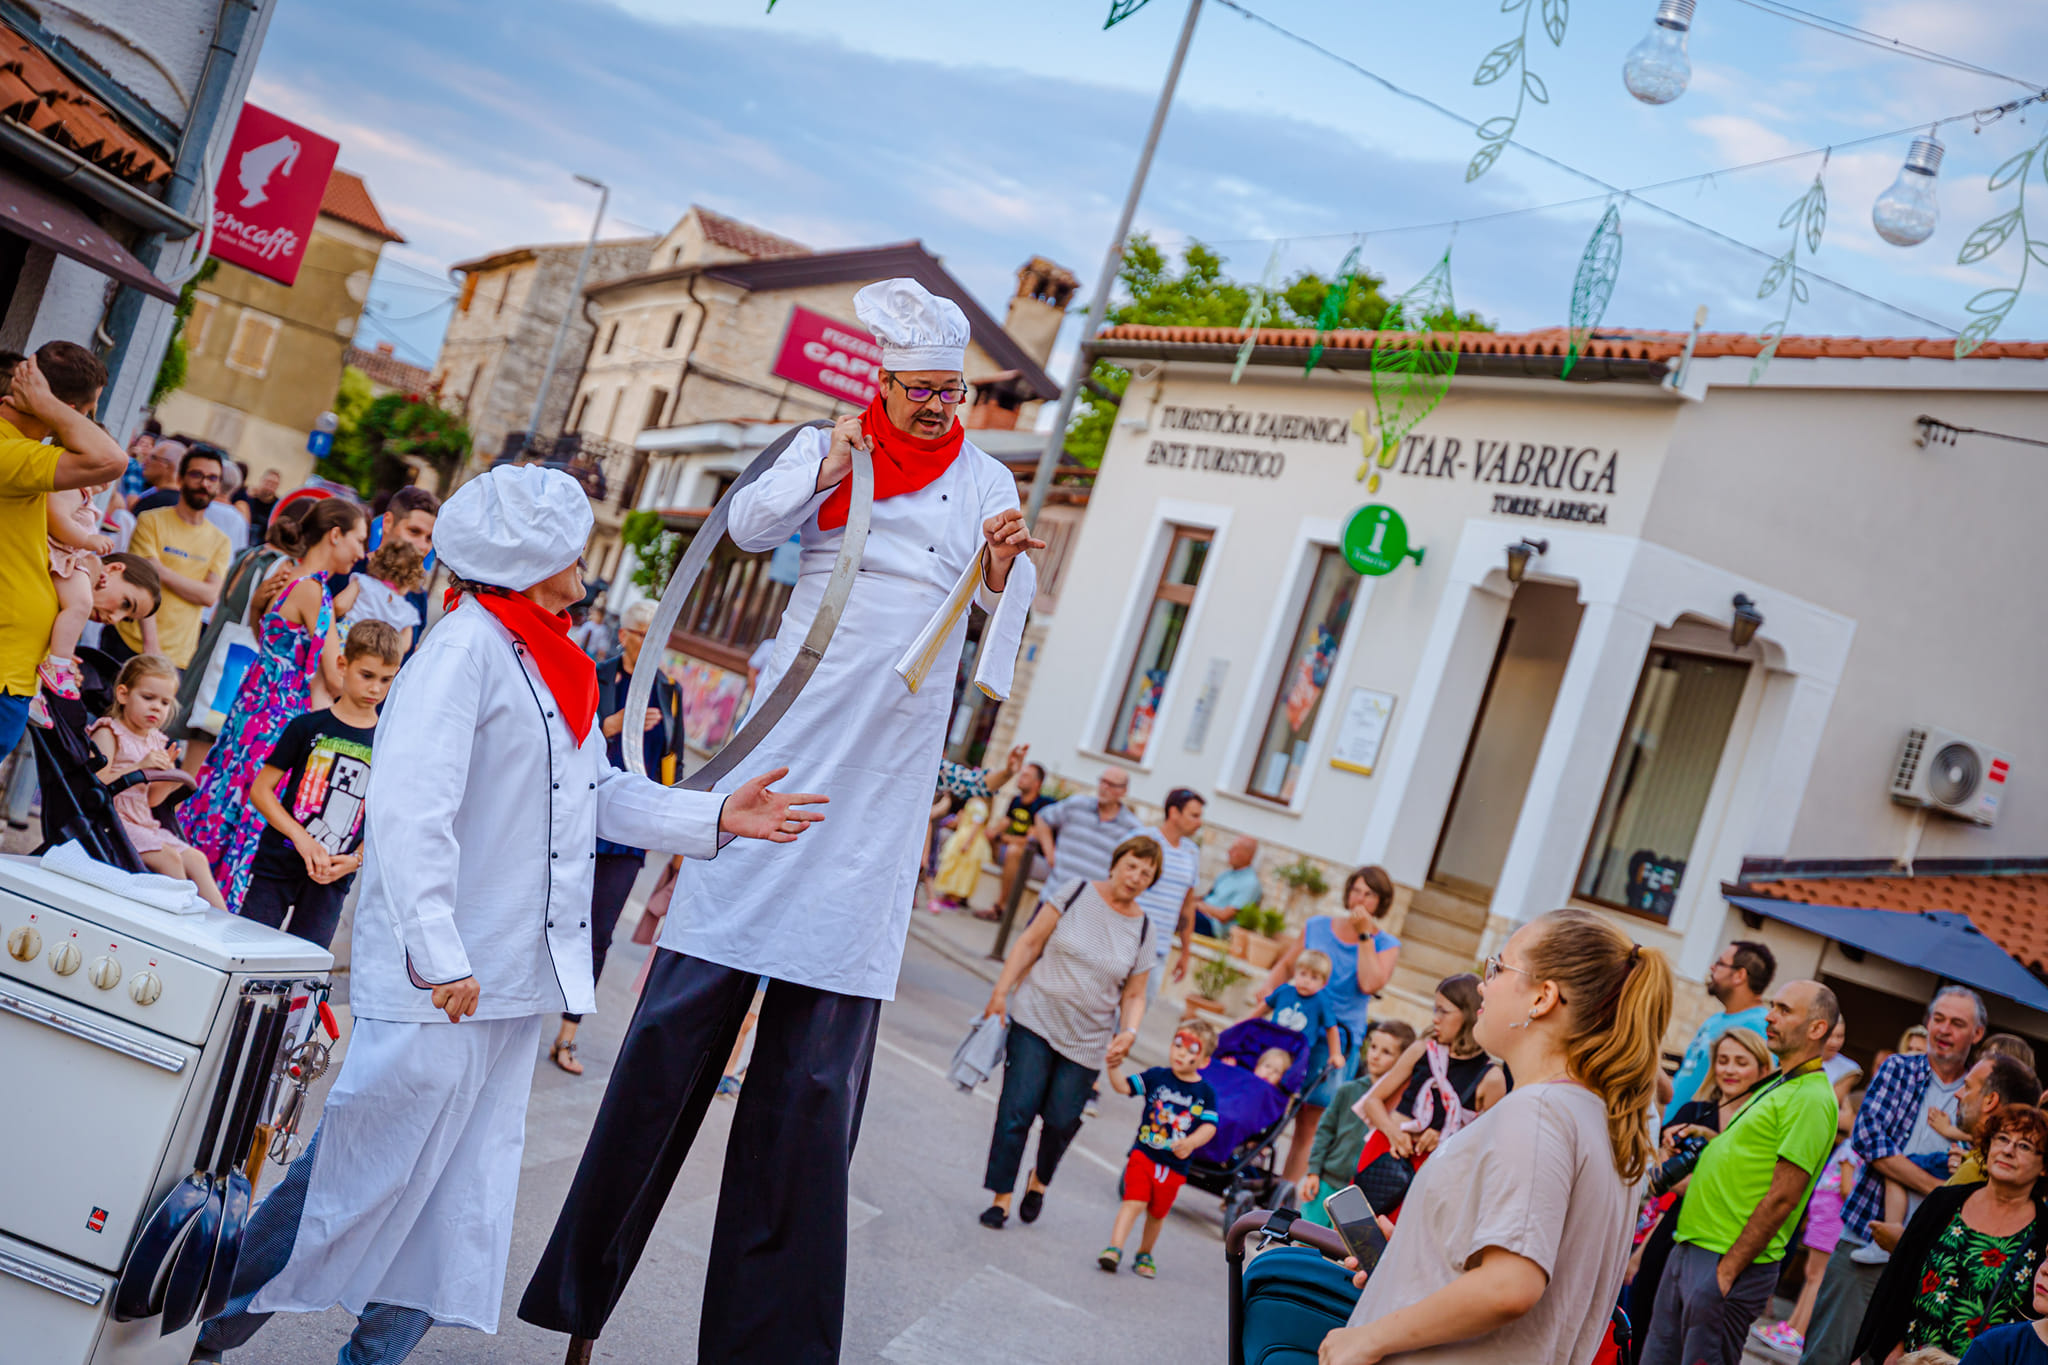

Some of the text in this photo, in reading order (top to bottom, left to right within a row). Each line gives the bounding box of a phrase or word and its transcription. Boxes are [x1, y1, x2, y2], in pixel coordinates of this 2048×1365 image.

[1161, 404, 1351, 444] TURISTIČKA ZAJEDNICA
[1146, 440, 1286, 479] ENTE TURISTICO
